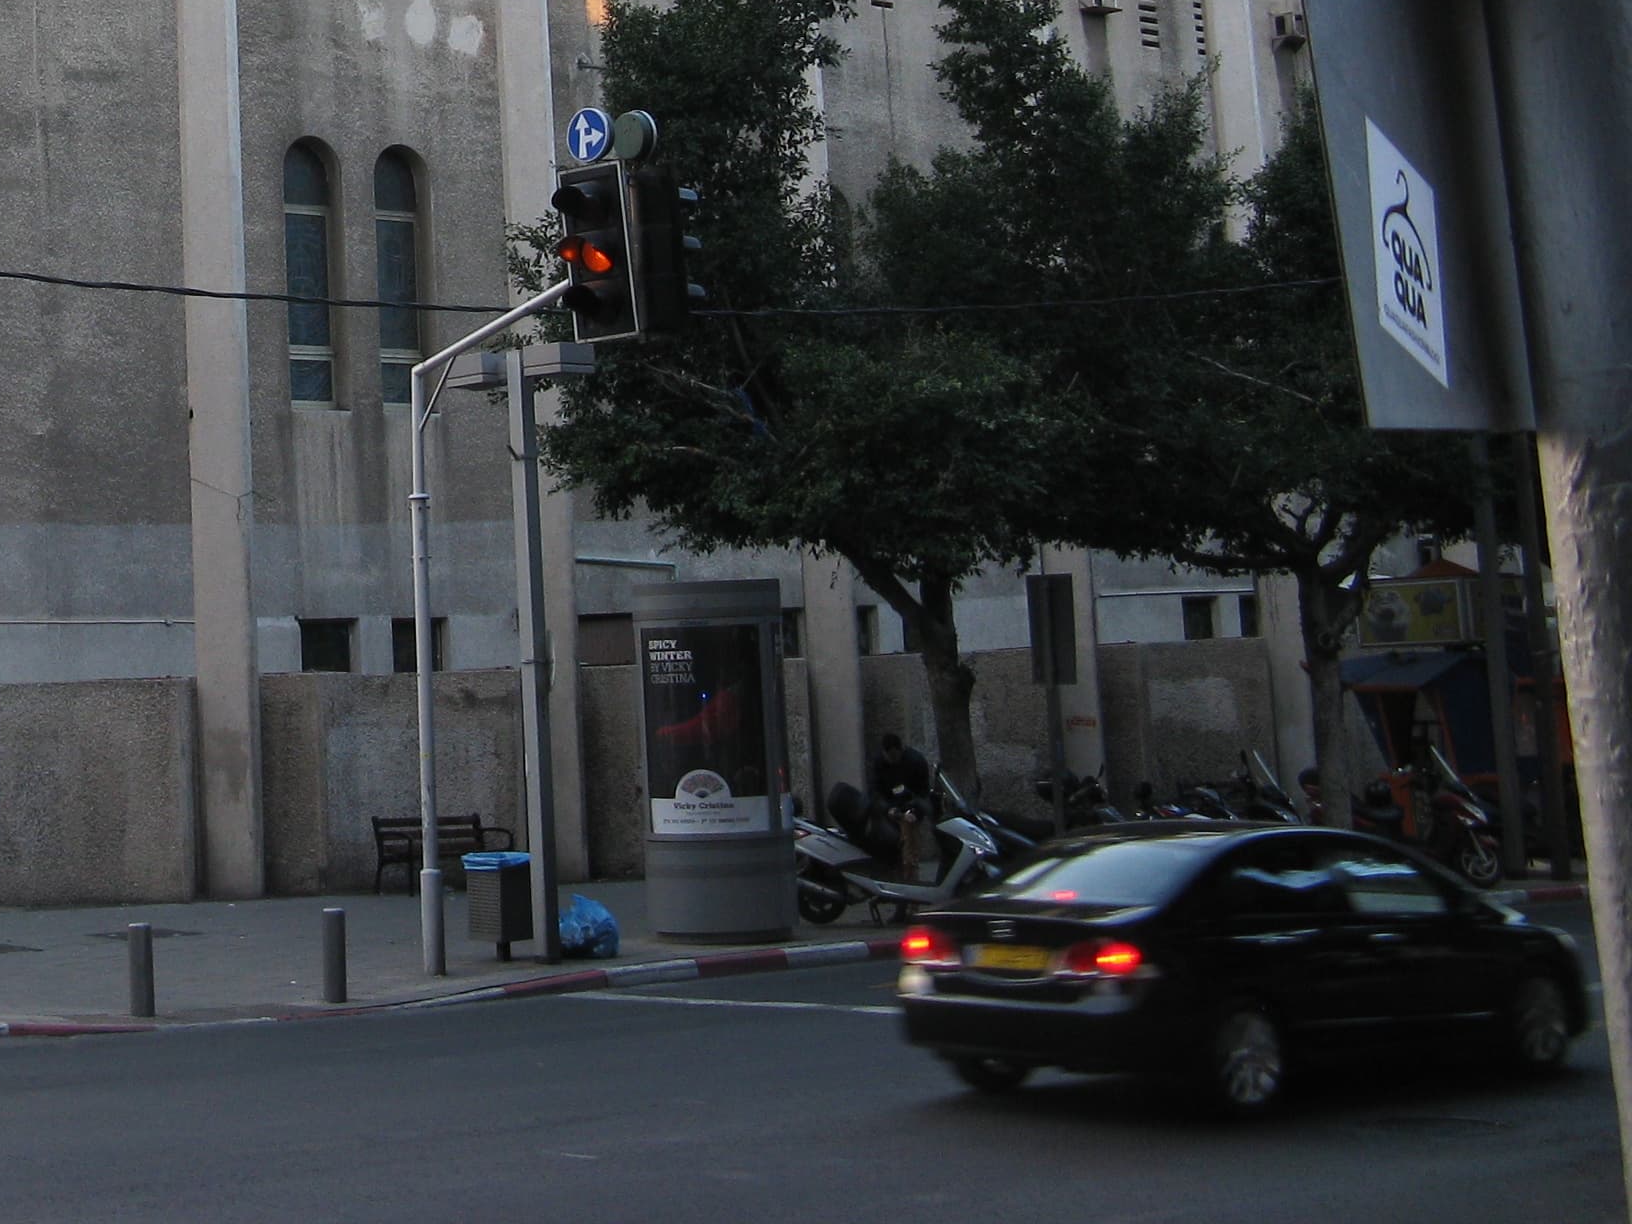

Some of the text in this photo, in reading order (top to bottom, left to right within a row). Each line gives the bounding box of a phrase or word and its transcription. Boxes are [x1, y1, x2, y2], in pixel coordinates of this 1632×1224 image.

[1391, 230, 1424, 290] QUA
[1394, 270, 1427, 329] QUA
[648, 639, 677, 650] SPICY
[649, 650, 693, 661] WINTER
[661, 662, 692, 673] VICKY
[673, 801, 735, 810] Vicky Cristina
